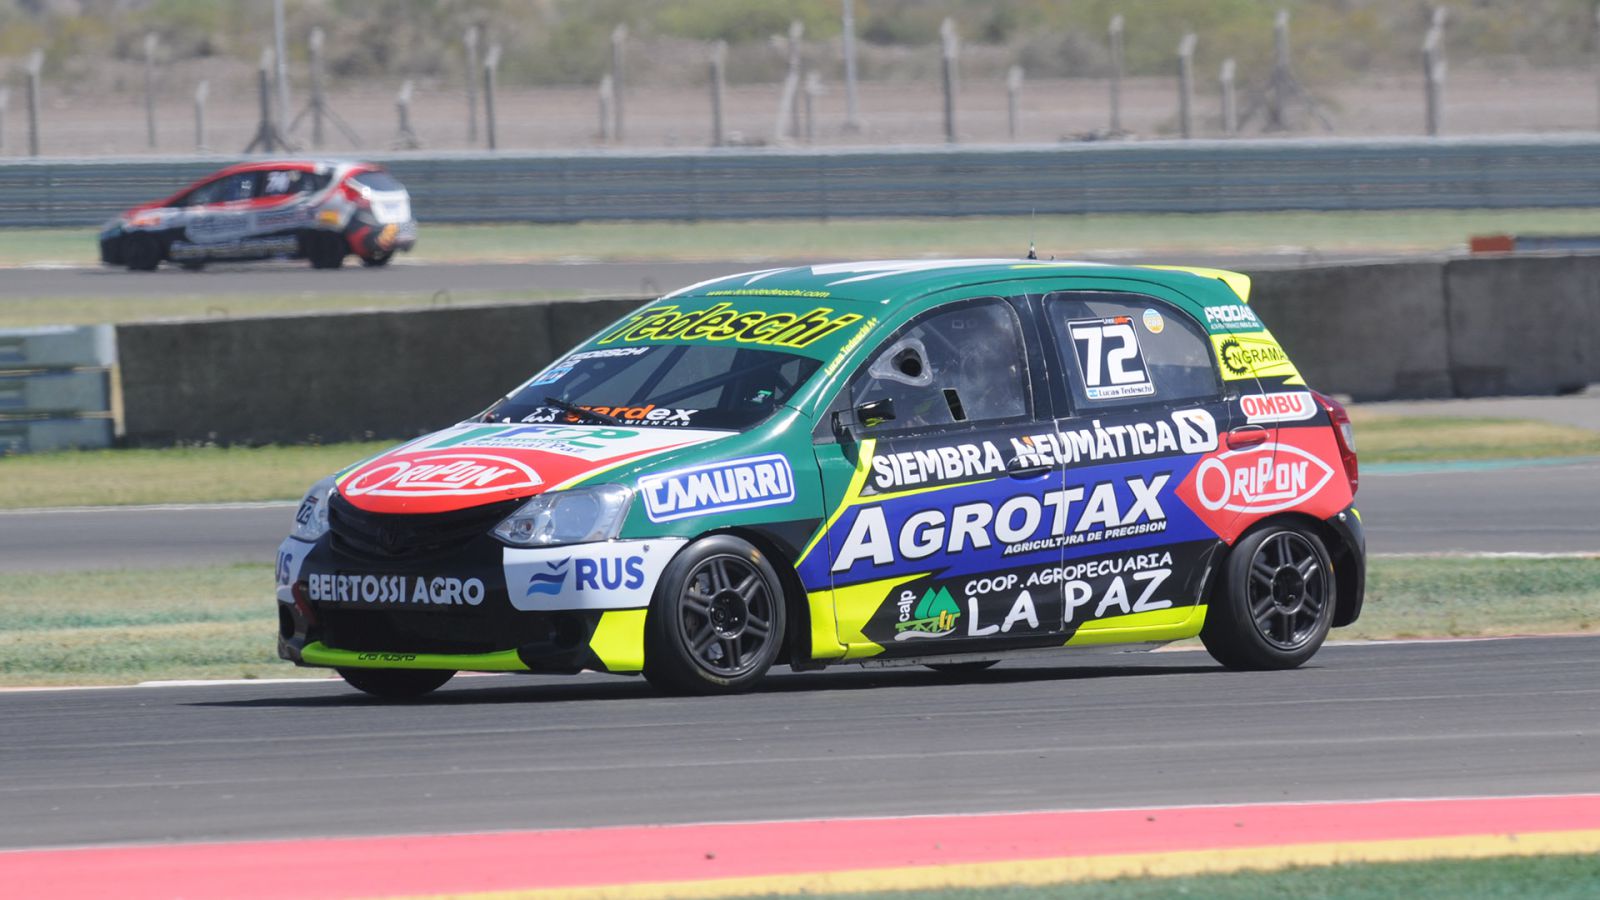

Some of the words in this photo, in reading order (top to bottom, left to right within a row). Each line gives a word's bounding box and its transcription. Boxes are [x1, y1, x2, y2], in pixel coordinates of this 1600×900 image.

[598, 302, 863, 348] Tedeschi
[1072, 324, 1146, 386] 72
[1099, 389, 1120, 397] Lucas
[1120, 384, 1153, 395] Tedeschi
[1243, 394, 1302, 418] OMBU
[872, 440, 1006, 489] SIEMBRA
[647, 461, 790, 514] CAMURRI
[831, 474, 1171, 572] AGROTAX
[1003, 534, 1085, 555] AGRICULTURA
[1087, 531, 1102, 541] DE
[1104, 521, 1167, 539] PRECISION
[411, 576, 486, 606] AGRO
[575, 556, 645, 591] RUS
[896, 590, 917, 622] calp
[968, 589, 1040, 637] LA
[1064, 568, 1174, 623] PAZ
